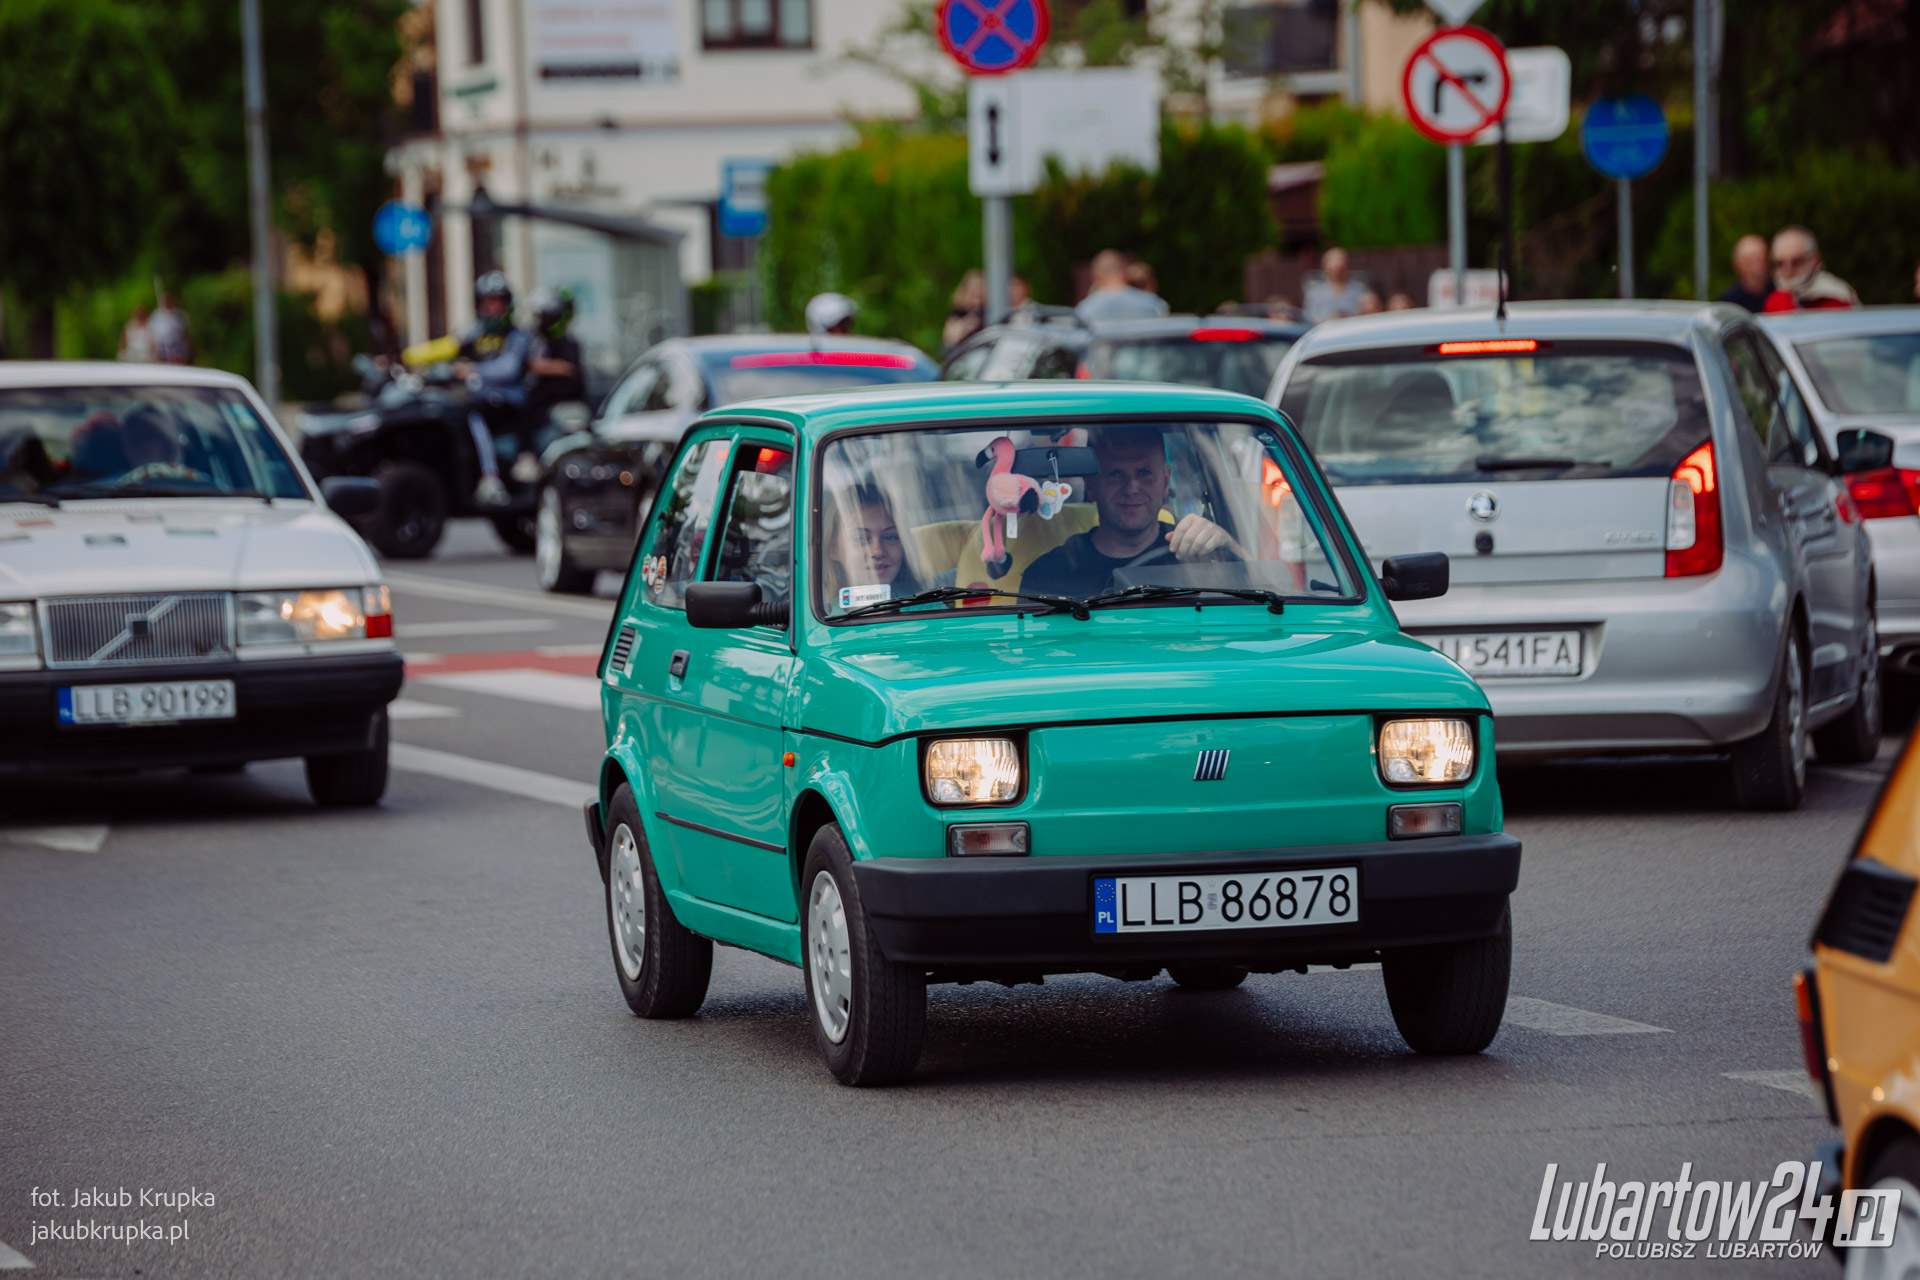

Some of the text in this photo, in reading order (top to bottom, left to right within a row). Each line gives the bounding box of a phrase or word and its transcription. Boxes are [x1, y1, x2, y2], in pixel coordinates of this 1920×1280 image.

[1474, 636, 1572, 667] 541FA
[76, 684, 228, 721] LLB 90199
[1121, 874, 1351, 926] LLB 86878
[1097, 911, 1115, 924] PL
